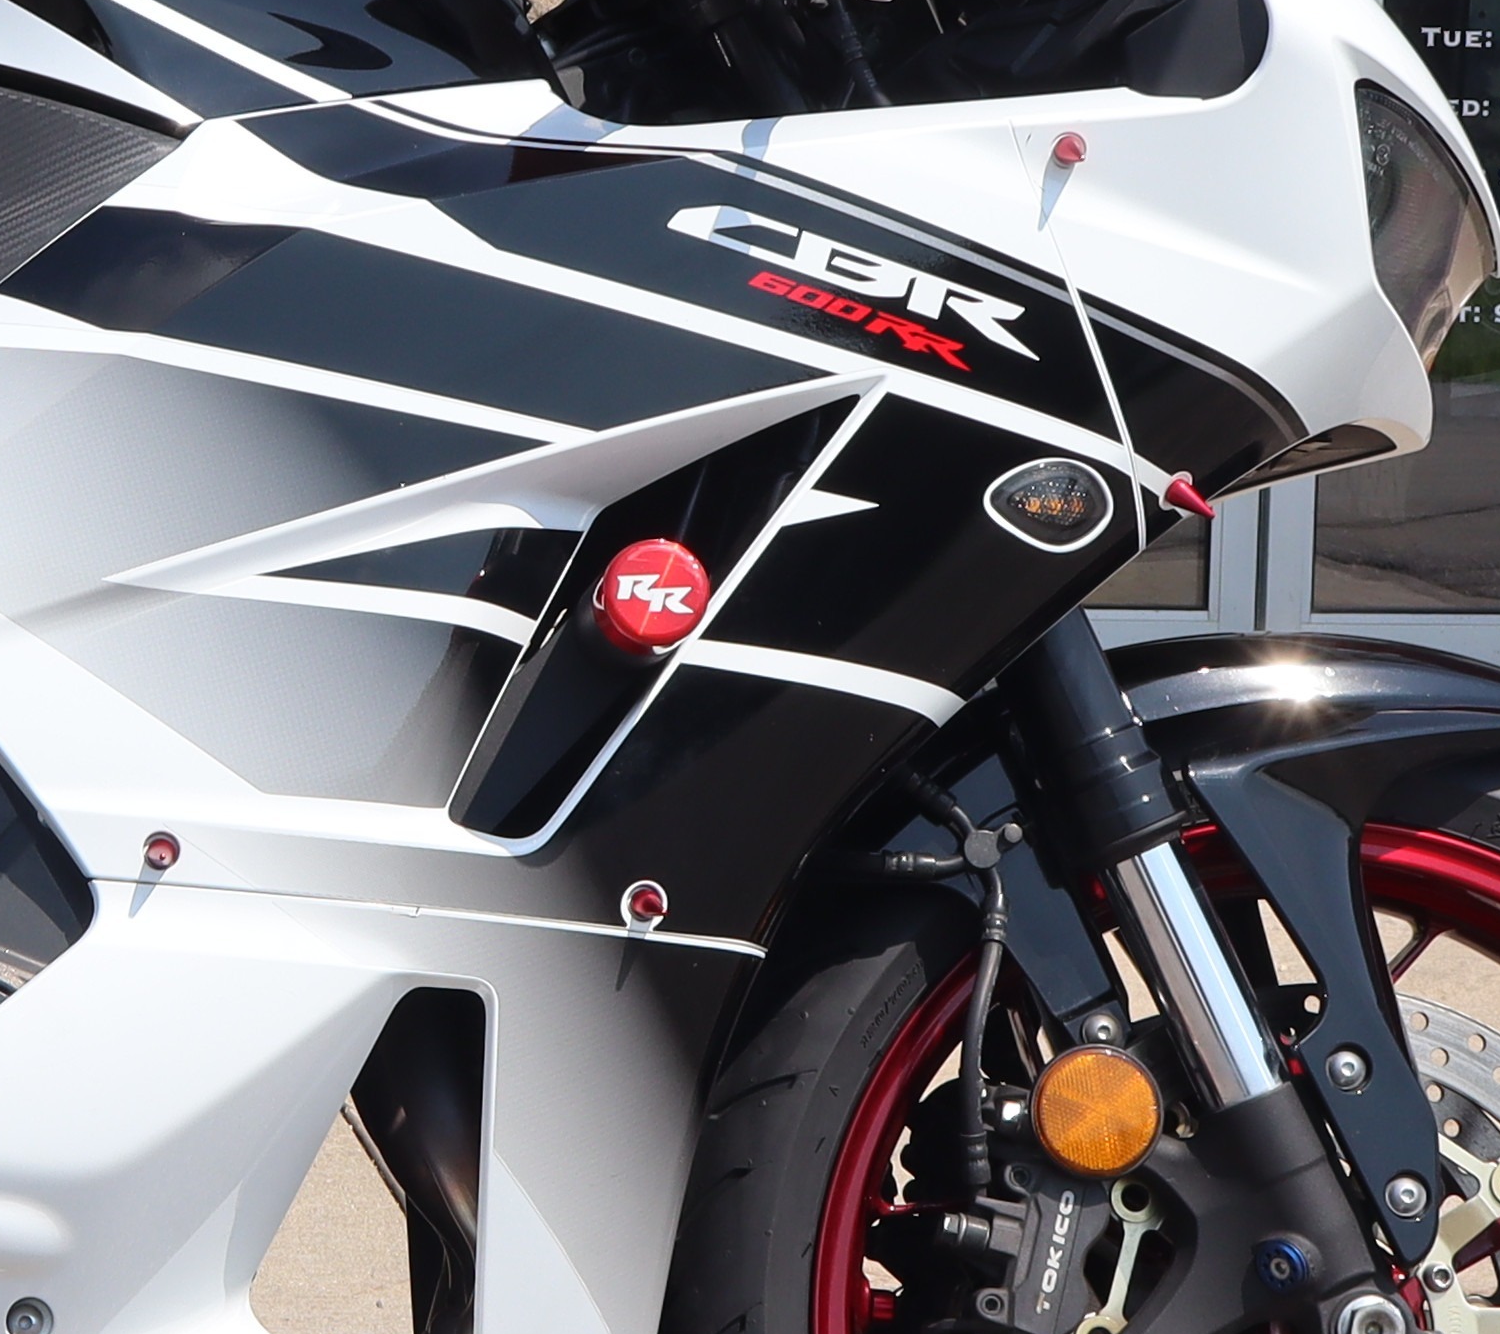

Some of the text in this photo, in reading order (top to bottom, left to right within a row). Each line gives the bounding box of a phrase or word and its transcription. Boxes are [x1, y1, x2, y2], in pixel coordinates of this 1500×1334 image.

[667, 204, 1040, 361] CBR
[748, 270, 971, 371] 600RR
[616, 574, 695, 614] RR
[1035, 1189, 1076, 1315] TOKICO
